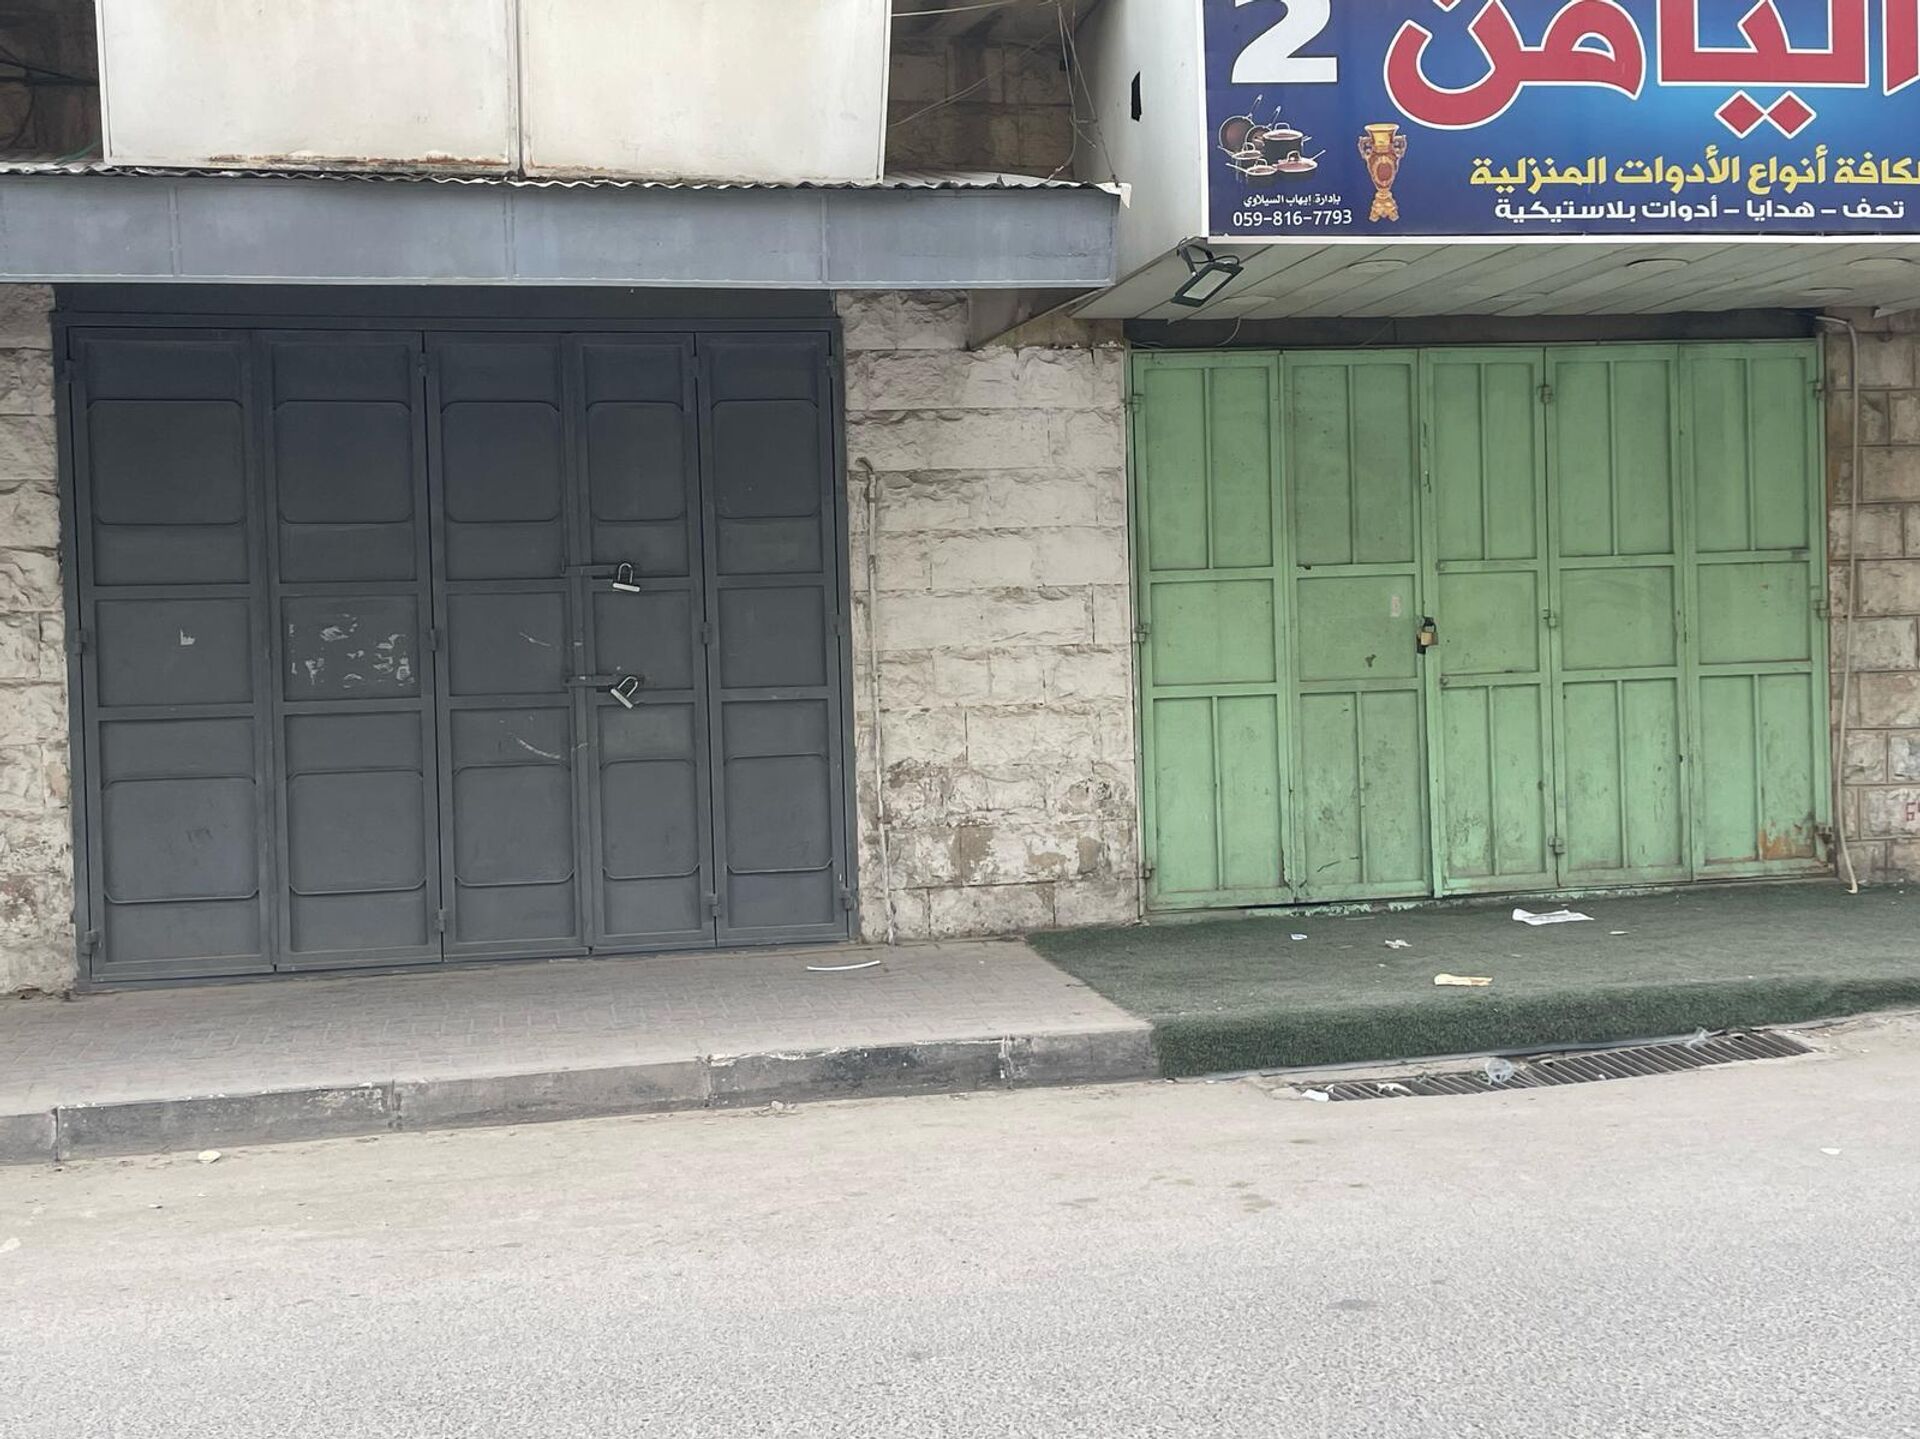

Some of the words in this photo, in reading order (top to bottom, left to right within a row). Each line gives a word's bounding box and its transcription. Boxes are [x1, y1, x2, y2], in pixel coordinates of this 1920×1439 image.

[1231, 0, 1338, 84] 2
[1470, 156, 1607, 195] المنزلية
[1614, 144, 1740, 195] الأدوات
[1747, 144, 1829, 196] أنواع
[1232, 209, 1353, 227] 059-816-7793
[1494, 198, 1637, 223] بلاستيكية
[1641, 195, 1718, 222] أدوات
[1746, 201, 1816, 222] هدايا
[1842, 198, 1905, 220] تحف
